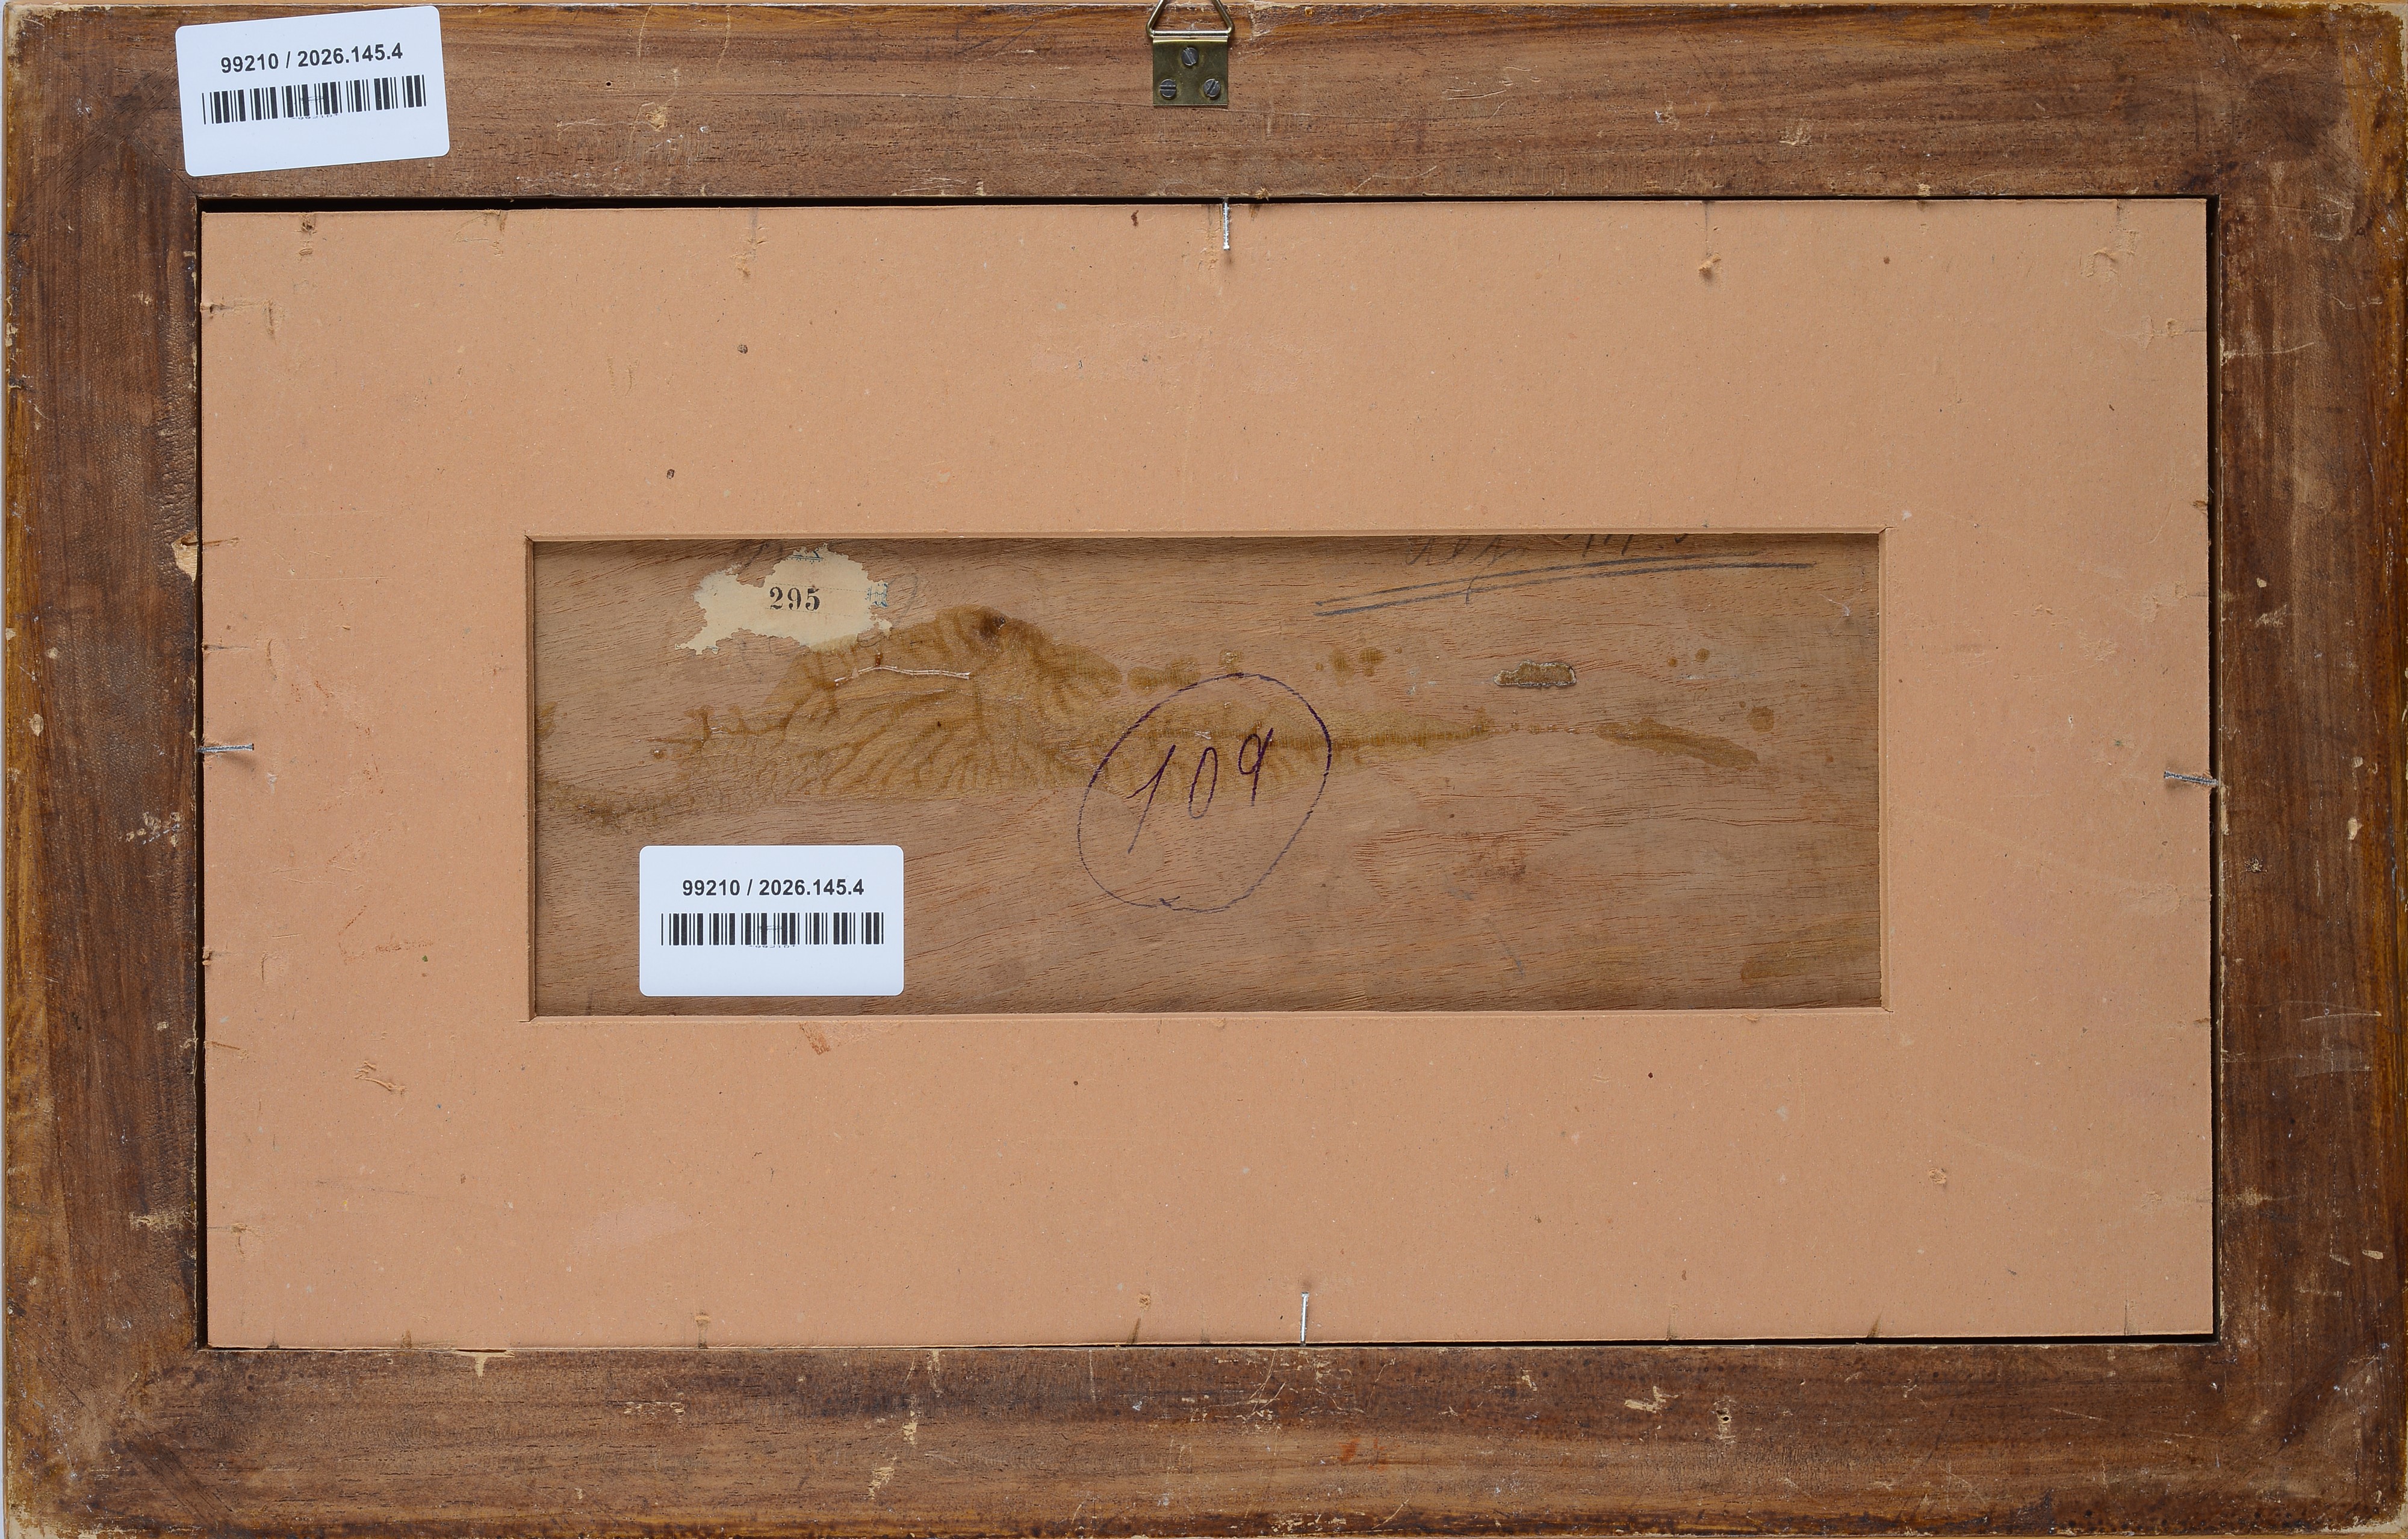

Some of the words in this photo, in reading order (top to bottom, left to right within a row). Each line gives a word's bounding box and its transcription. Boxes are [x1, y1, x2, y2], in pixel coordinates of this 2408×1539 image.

[220, 52, 279, 73] 99210
[285, 51, 291, 69] /
[297, 42, 403, 68] 2026.145.4
[769, 586, 821, 612] 295
[1126, 727, 1274, 854] 109
[682, 879, 740, 896] 99210
[746, 878, 753, 896] /
[759, 878, 865, 896] 2026.145.4
